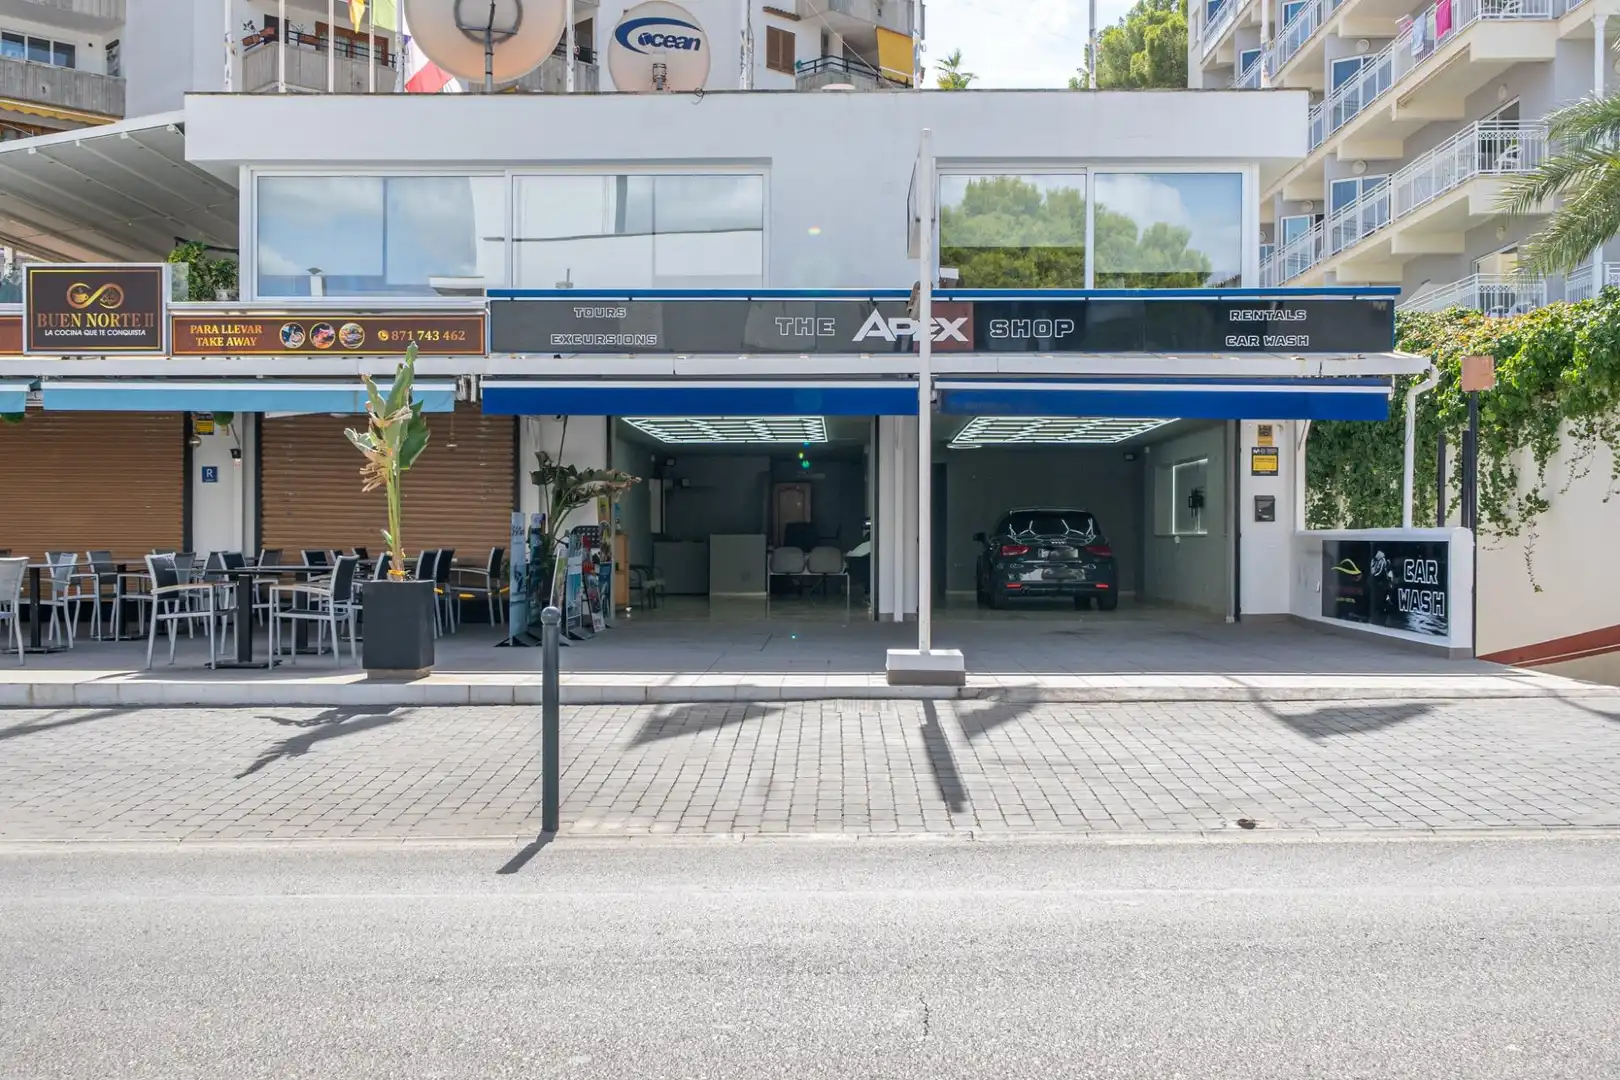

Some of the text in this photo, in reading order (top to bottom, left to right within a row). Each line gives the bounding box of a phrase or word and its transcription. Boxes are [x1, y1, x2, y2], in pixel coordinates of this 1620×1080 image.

[574, 307, 627, 318] TOURS
[1229, 310, 1307, 321] RENTALS
[37, 313, 155, 328] BUEN NORTE II
[775, 308, 1075, 342] THE APEX SHOP
[190, 324, 263, 334] PARA LLEVAR
[391, 330, 466, 341] 871 743 462
[550, 334, 658, 345] EXCURSIONS
[1225, 335, 1310, 347] CAR WASH
[196, 337, 257, 347] TAKE AWAY
[206, 468, 214, 478] R
[1403, 559, 1439, 585] CAR
[1398, 588, 1445, 617] WASH
